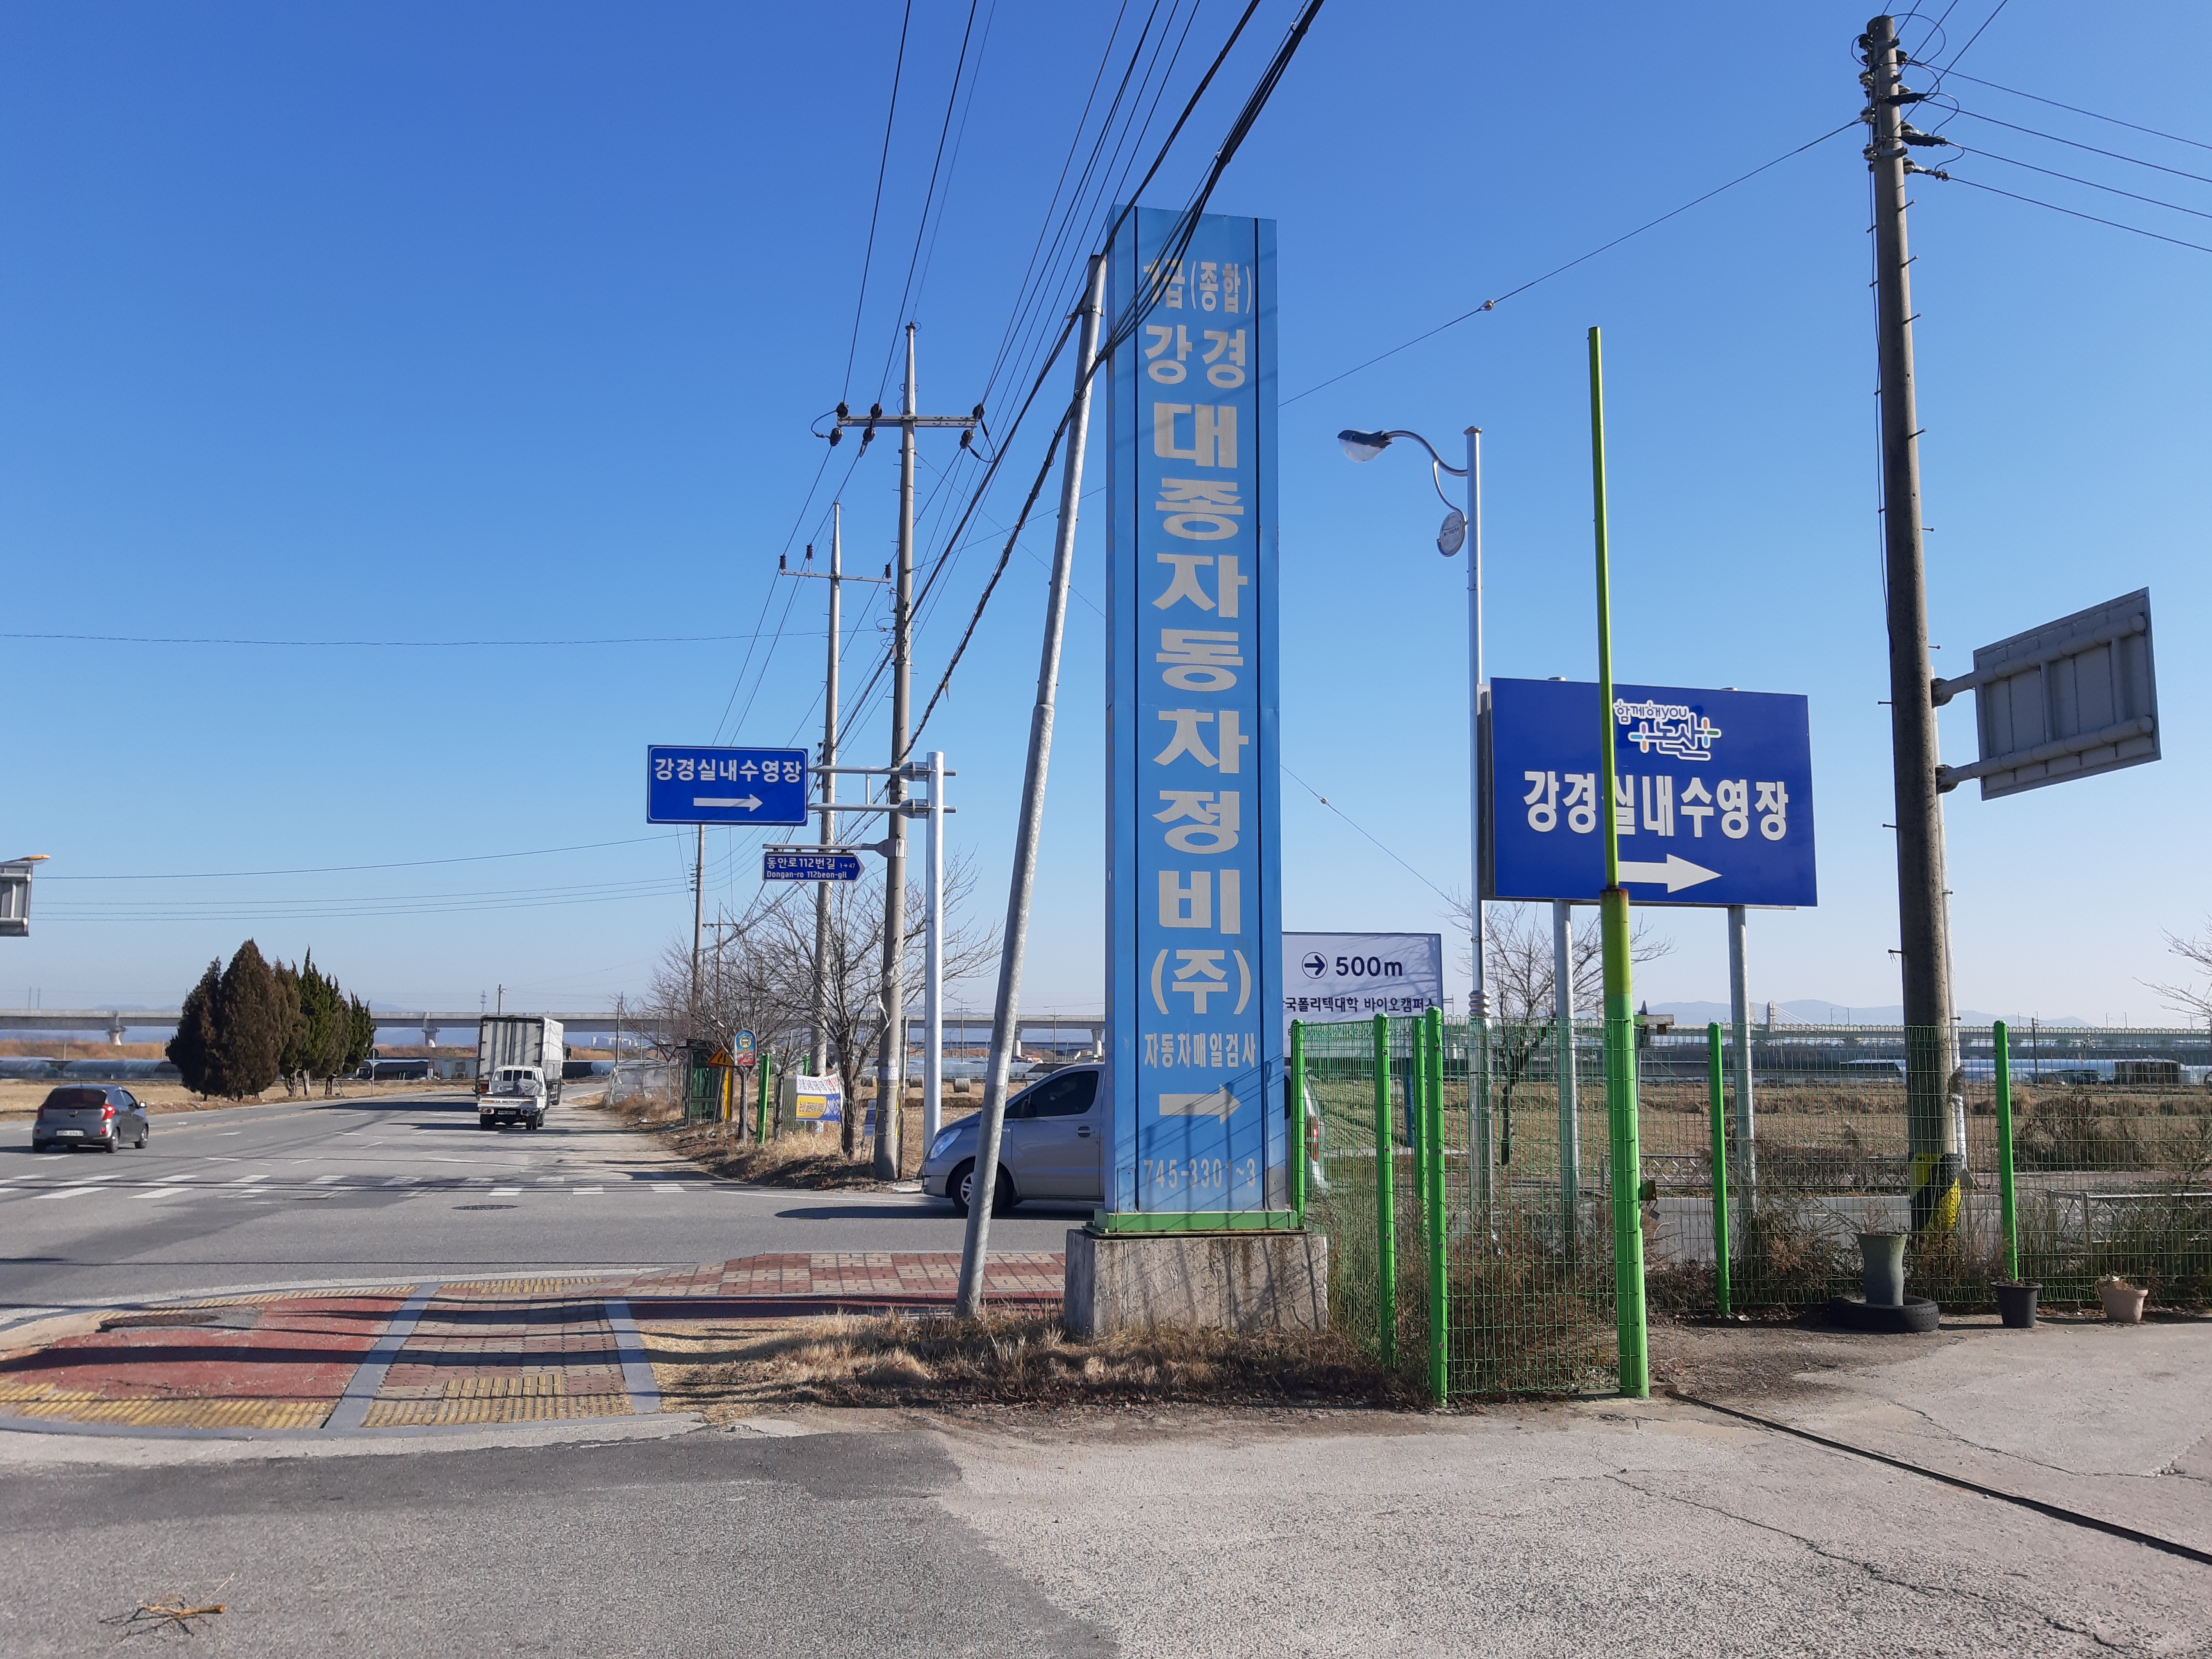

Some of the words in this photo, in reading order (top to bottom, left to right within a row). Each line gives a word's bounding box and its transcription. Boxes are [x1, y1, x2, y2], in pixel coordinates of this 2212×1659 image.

[1144, 325, 1246, 389] 강경
[654, 758, 802, 783] 강경실내수영장
[1523, 771, 1789, 841] 강경실내수영장
[767, 858, 835, 870] 동안로112번길
[807, 871, 847, 879] 112beon-gil
[1336, 956, 1403, 976] 500m
[1283, 997, 1358, 1012] 국폴리텍대학
[1144, 1033, 1256, 1068] 자동차매일검사
